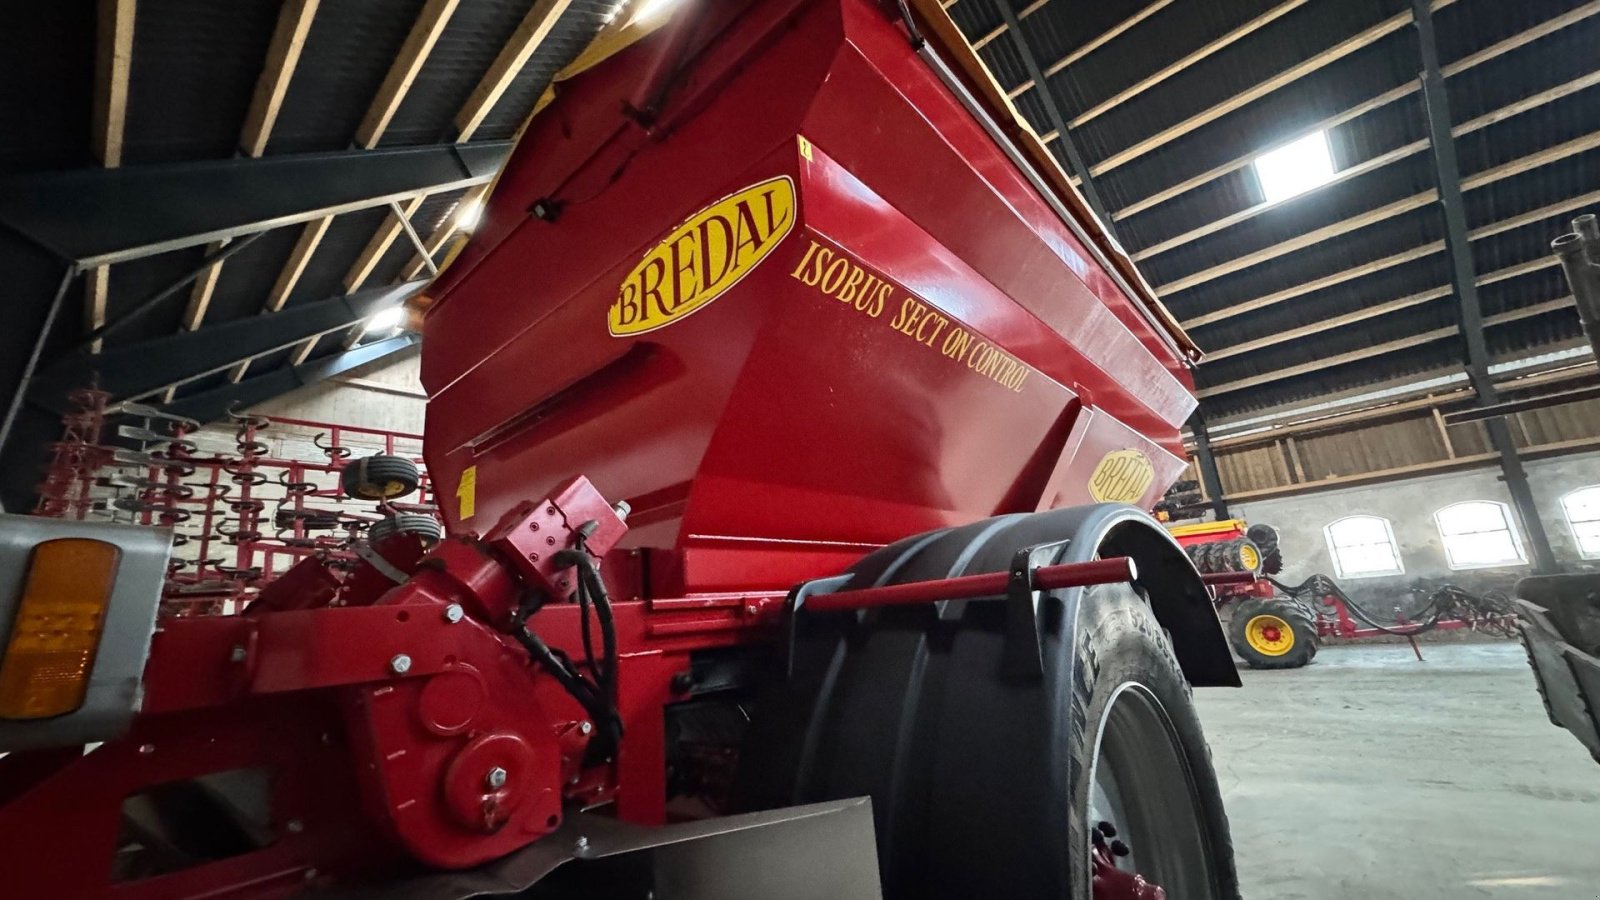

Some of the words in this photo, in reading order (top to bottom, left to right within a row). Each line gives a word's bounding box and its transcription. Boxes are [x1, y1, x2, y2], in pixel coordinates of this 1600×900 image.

[619, 189, 789, 326] BREDAL
[789, 240, 895, 318] ISOBUS
[967, 341, 1031, 393] CONTROL
